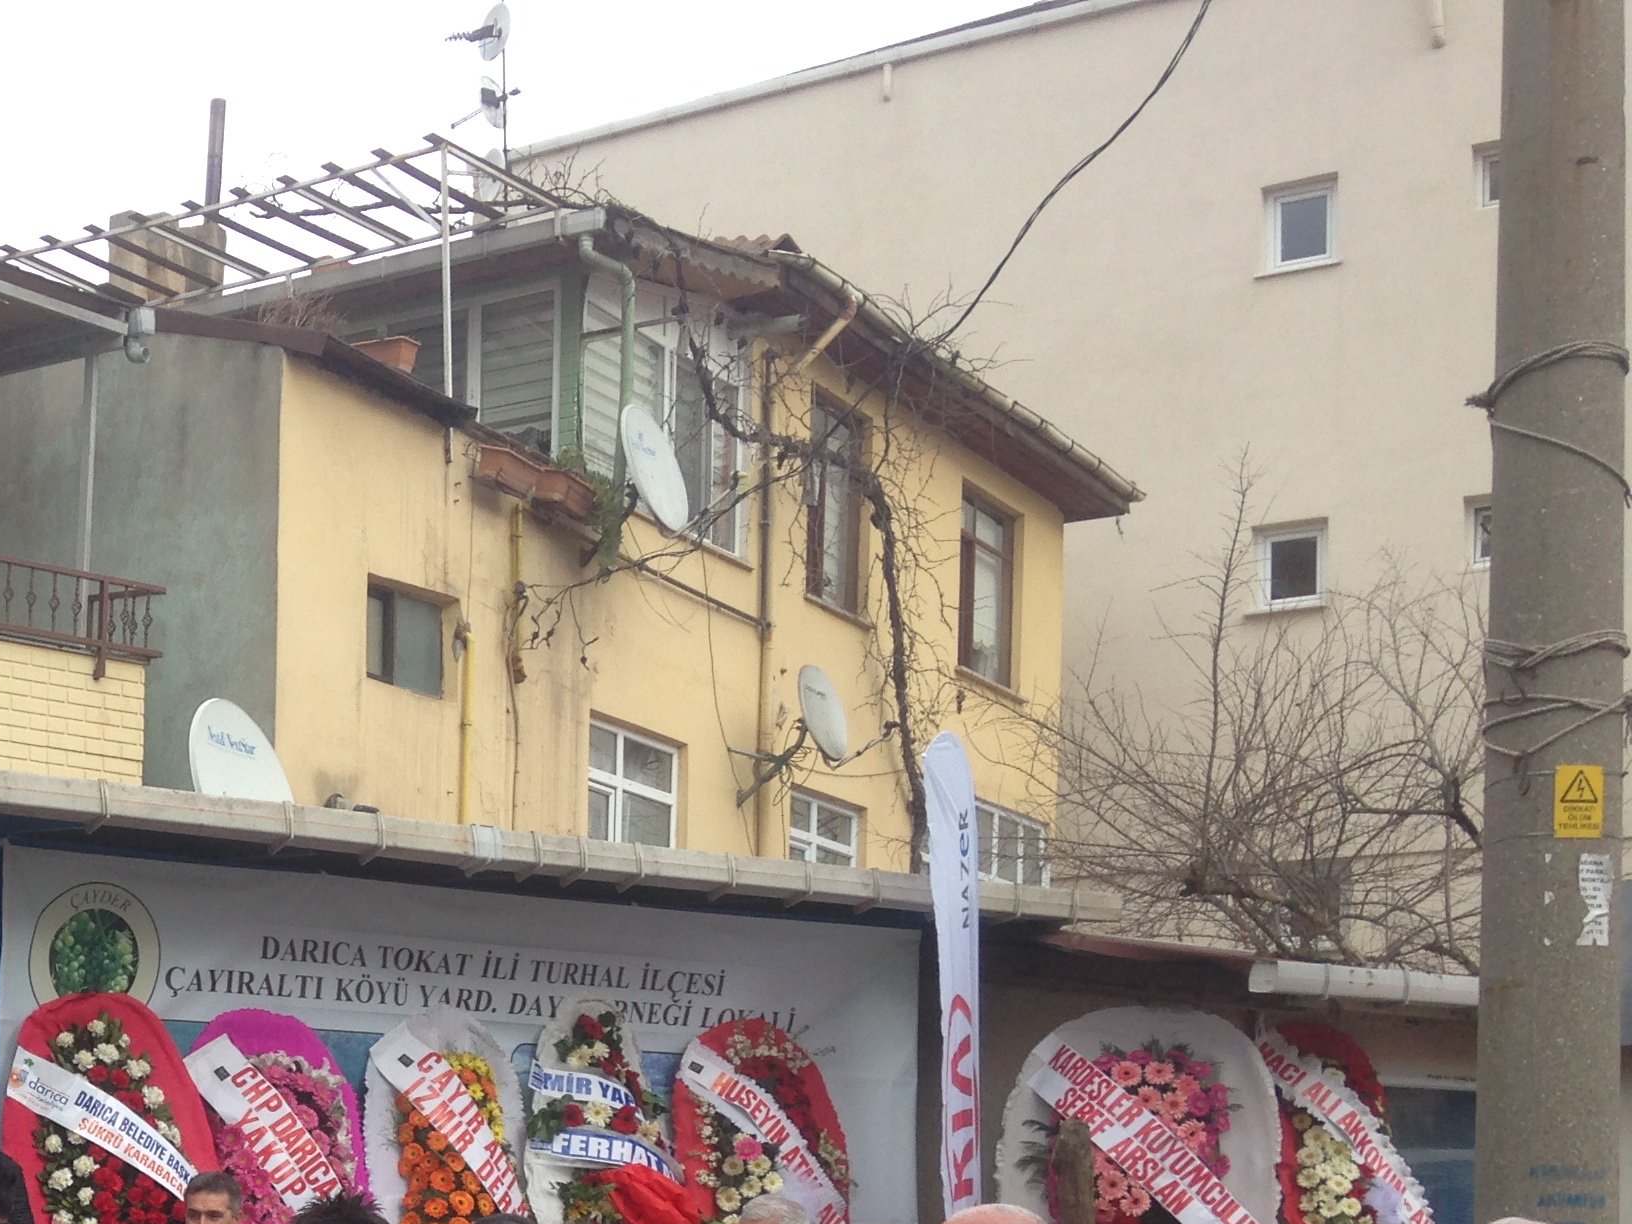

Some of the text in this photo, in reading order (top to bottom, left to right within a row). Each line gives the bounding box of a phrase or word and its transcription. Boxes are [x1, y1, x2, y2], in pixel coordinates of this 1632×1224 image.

[165, 966, 323, 999] ÇAYIRALTI
[334, 974, 409, 1006] KÖYÜ
[260, 936, 726, 1000] DARICA TOKAT İLİ TURHAL İLÇESİ
[74, 1090, 120, 1128] DARICA
[230, 1066, 340, 1202] CHP DARICA
[235, 1106, 308, 1197] YAKUP
[552, 1132, 660, 1171] FERHAT
[1108, 1135, 1194, 1216] ARSLAN
[475, 1157, 514, 1214] DER
